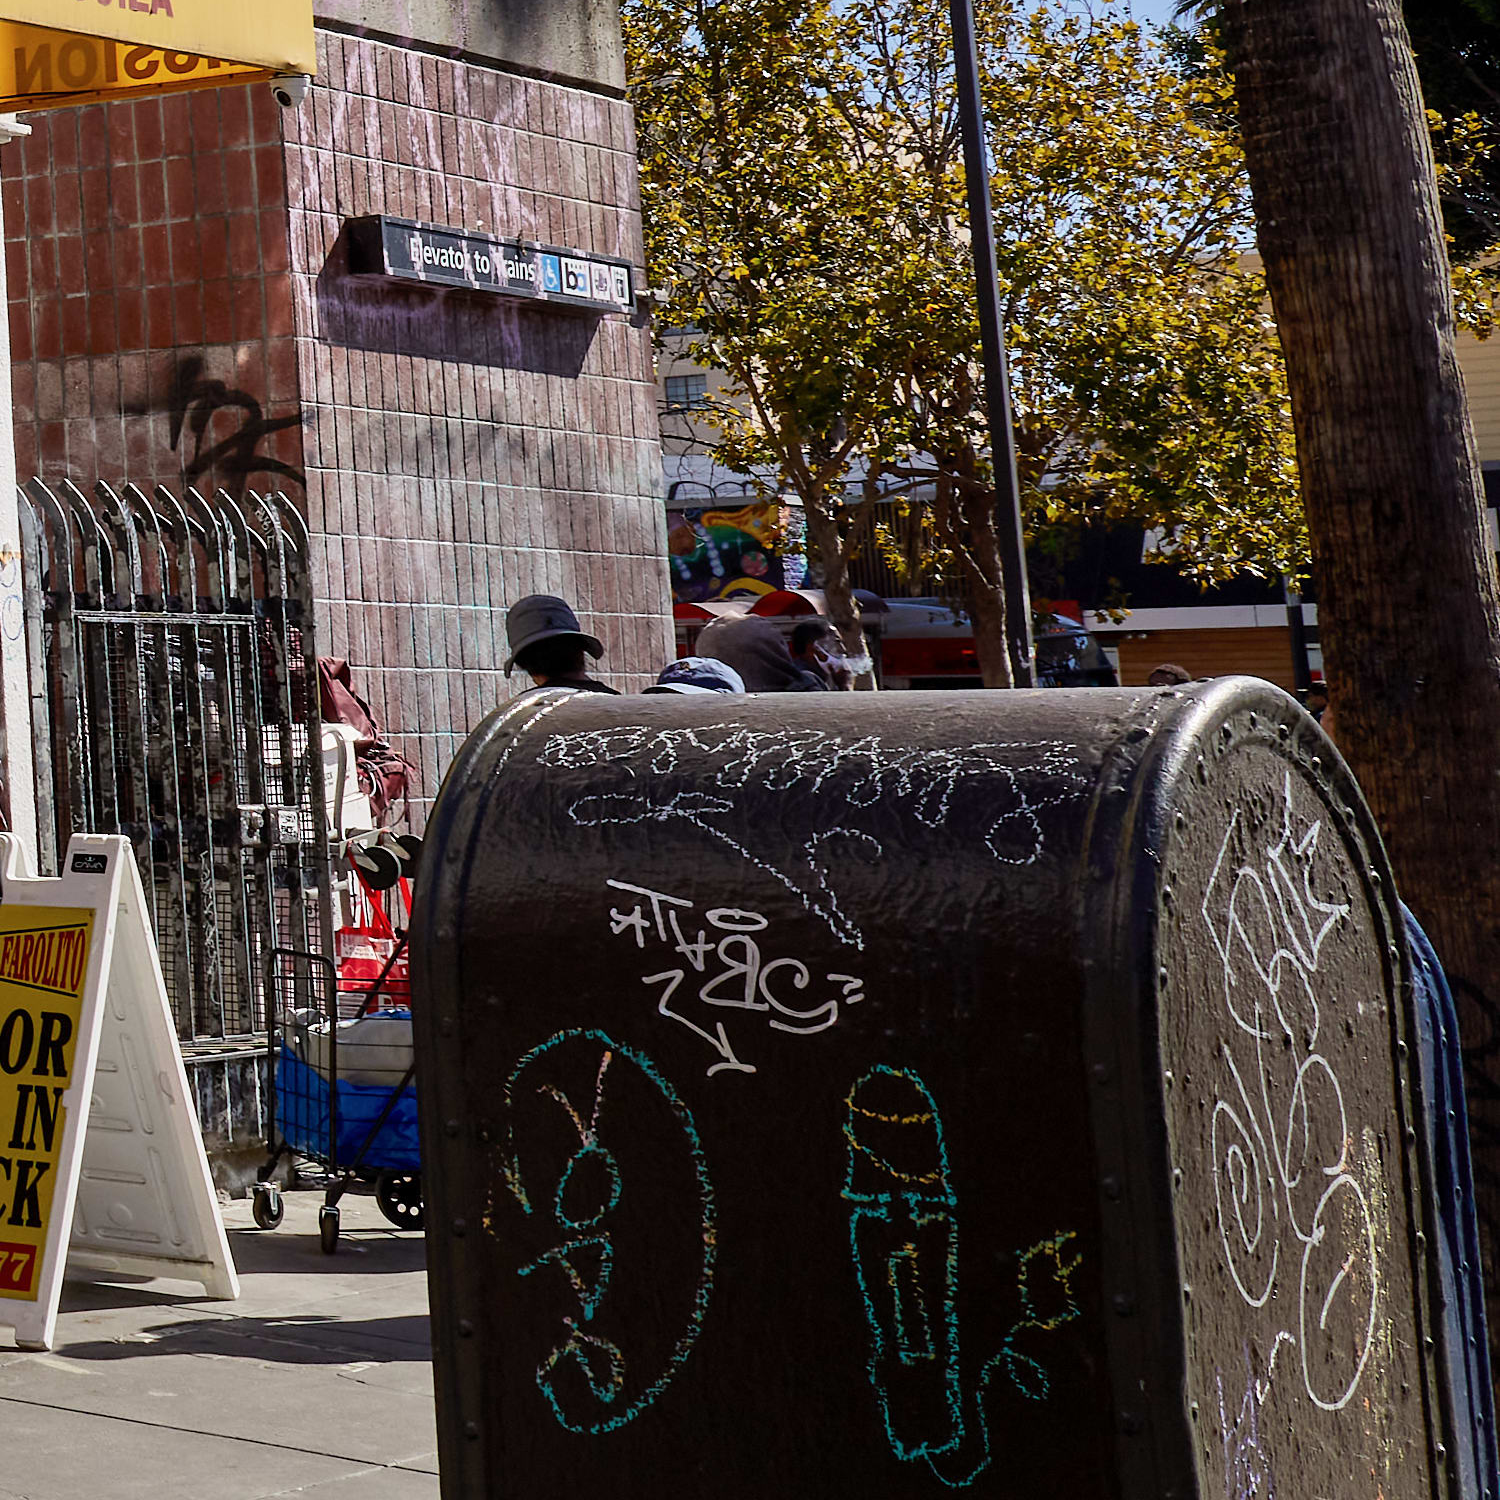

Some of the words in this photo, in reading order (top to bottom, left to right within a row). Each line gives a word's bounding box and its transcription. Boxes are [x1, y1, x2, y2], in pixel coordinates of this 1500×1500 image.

[474, 250, 491, 274] to
[0, 928, 86, 992] FAROLITO
[8, 1083, 64, 1153] IN
